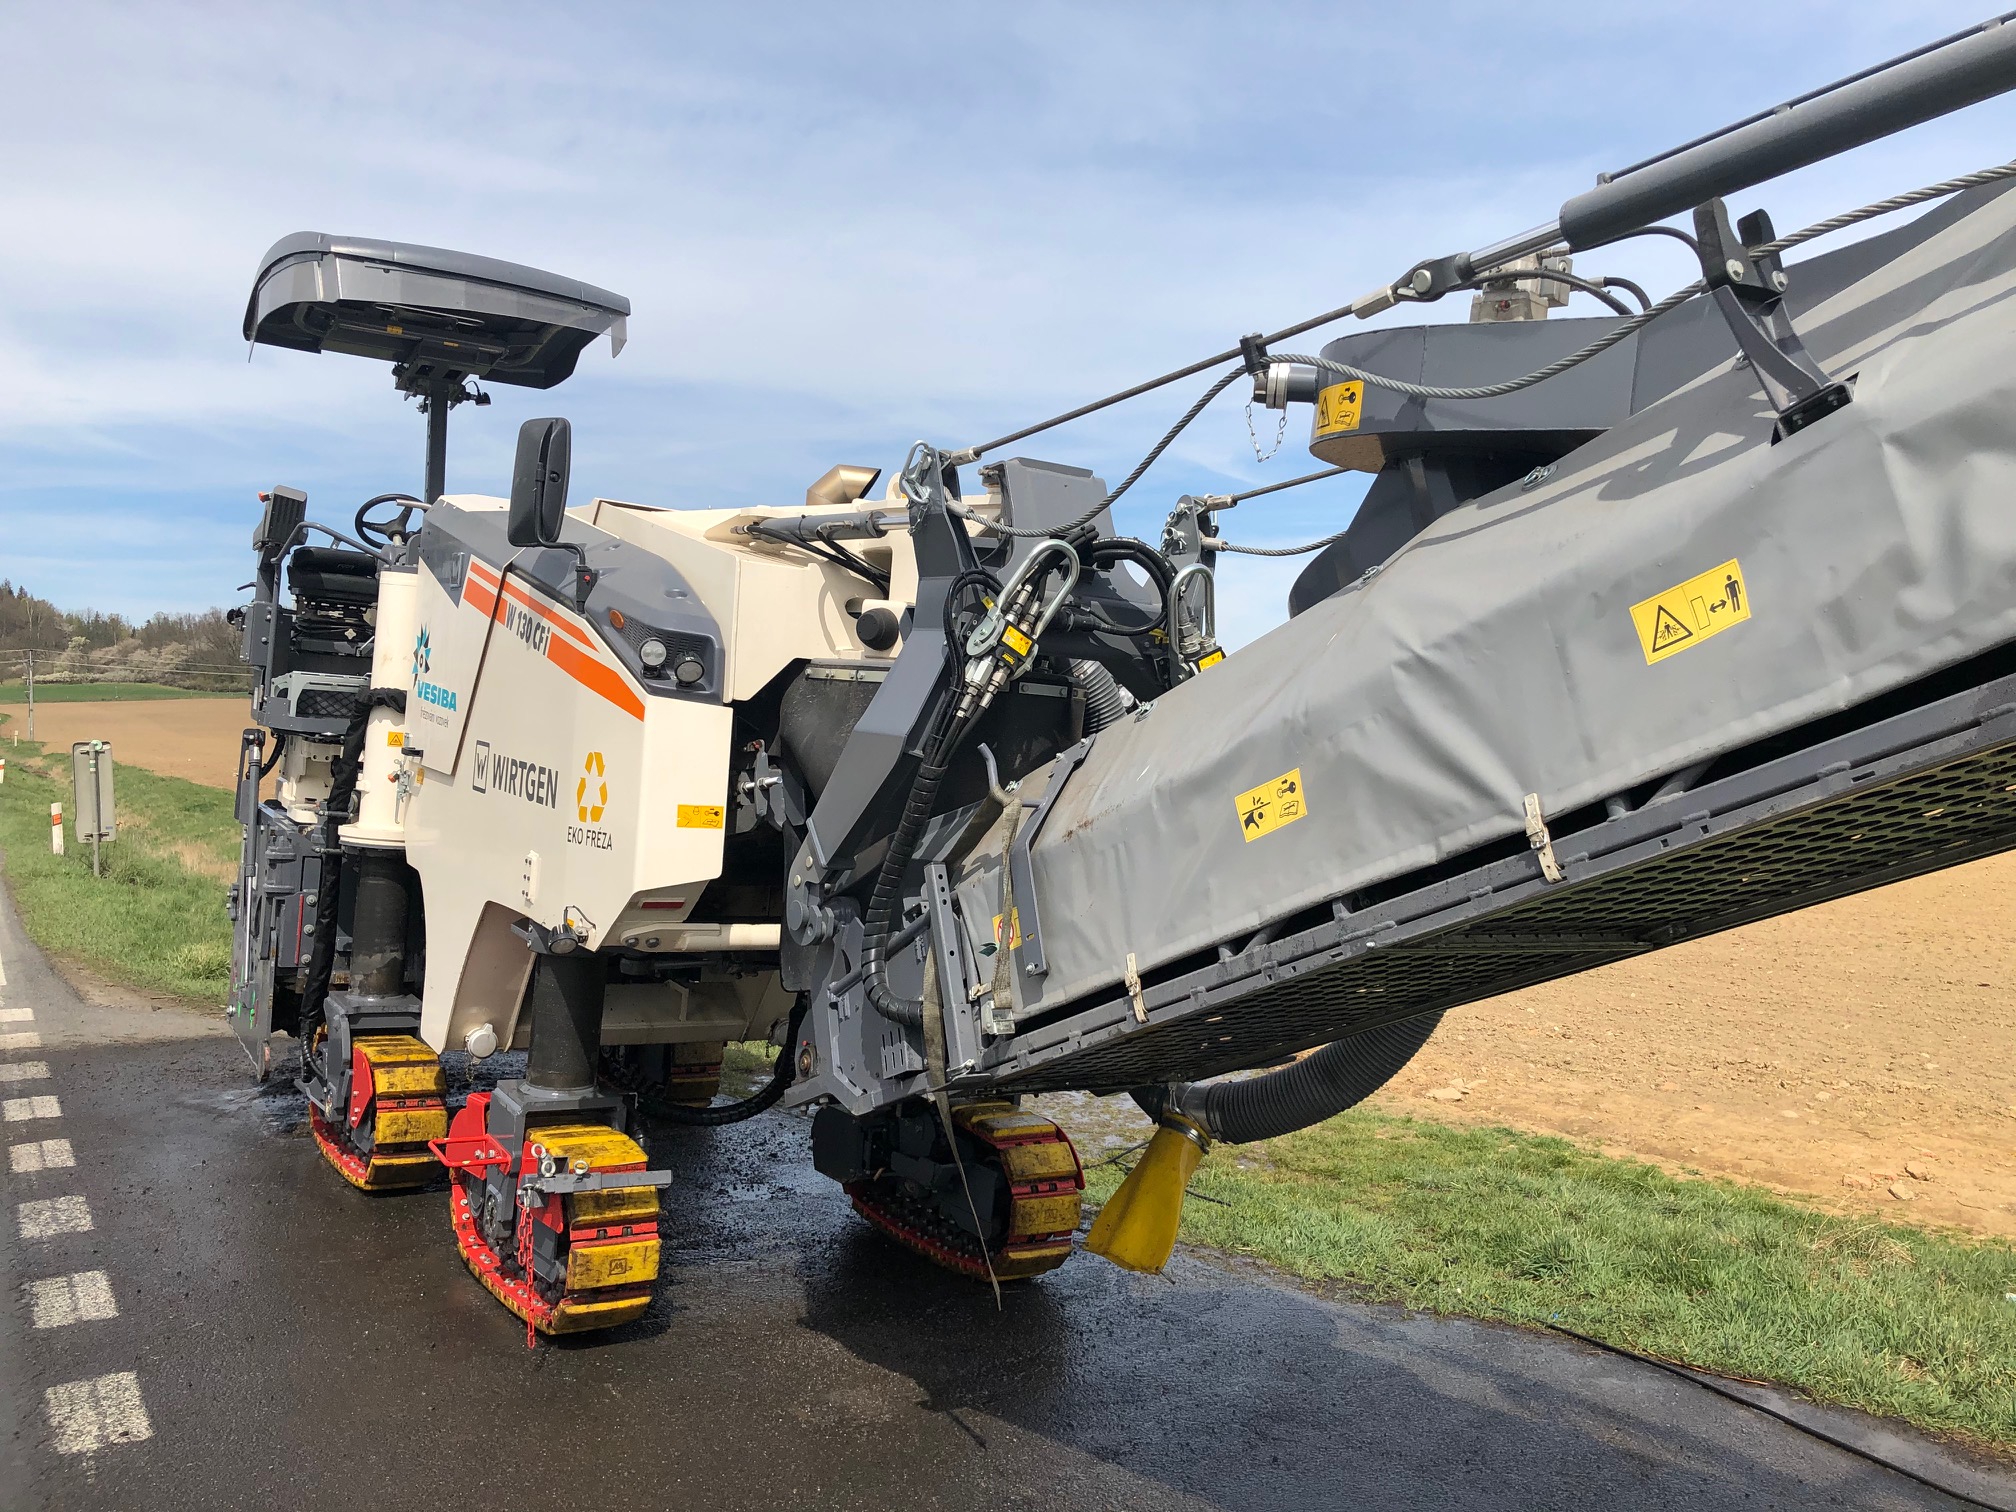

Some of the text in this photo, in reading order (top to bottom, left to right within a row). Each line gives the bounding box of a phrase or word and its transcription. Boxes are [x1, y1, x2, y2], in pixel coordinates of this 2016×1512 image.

[506, 602, 551, 656] W 130 CFi
[417, 680, 457, 712] VESIBA
[492, 753, 559, 809] WIRTGEN
[567, 825, 613, 851] EKO FRÉZA
